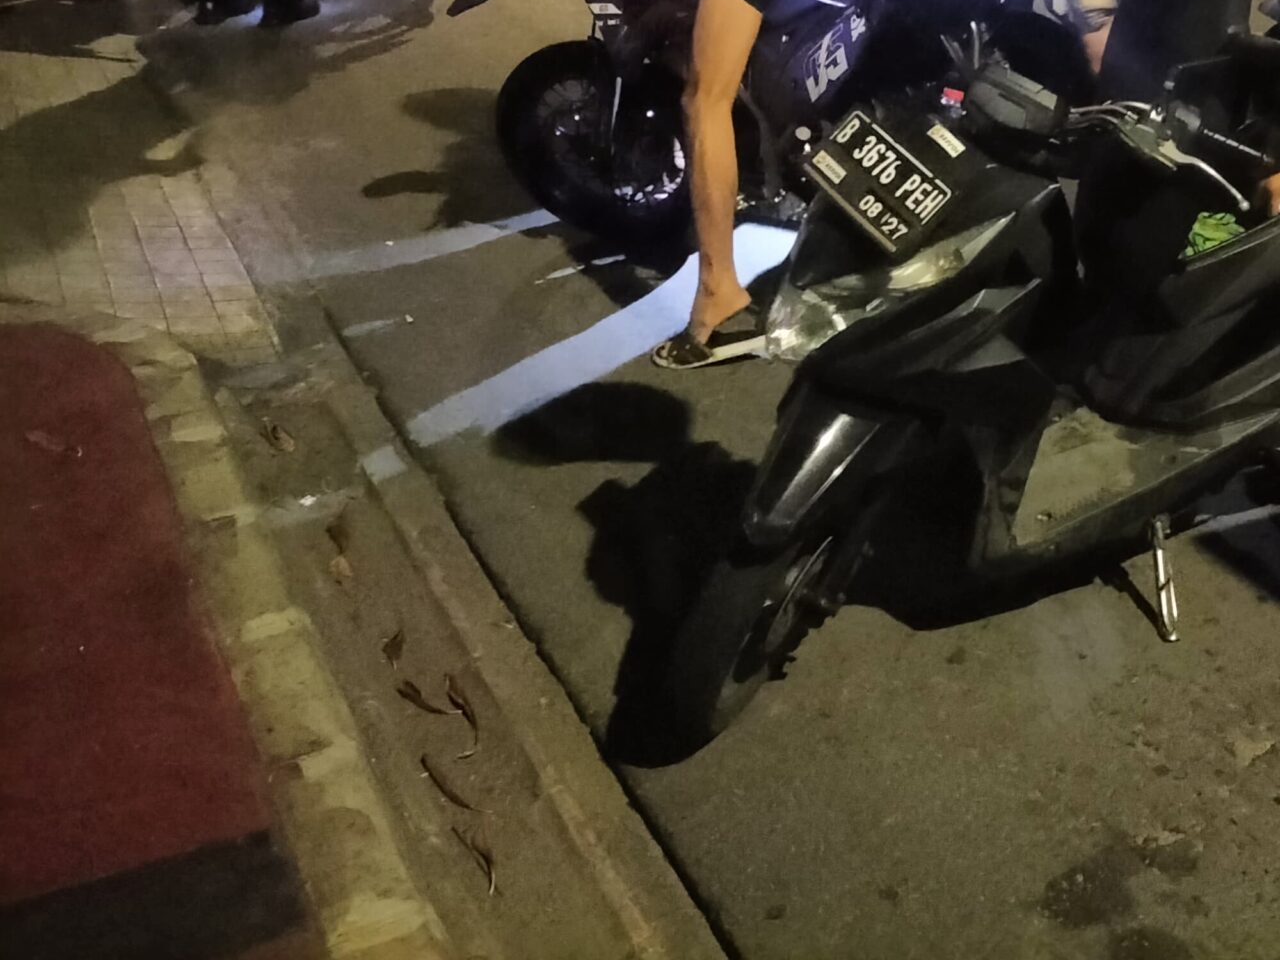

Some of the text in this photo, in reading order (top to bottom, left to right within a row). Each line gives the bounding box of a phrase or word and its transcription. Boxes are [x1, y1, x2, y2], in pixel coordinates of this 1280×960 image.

[836, 118, 860, 143] B
[852, 135, 902, 184] 3676
[894, 174, 944, 219] PEH
